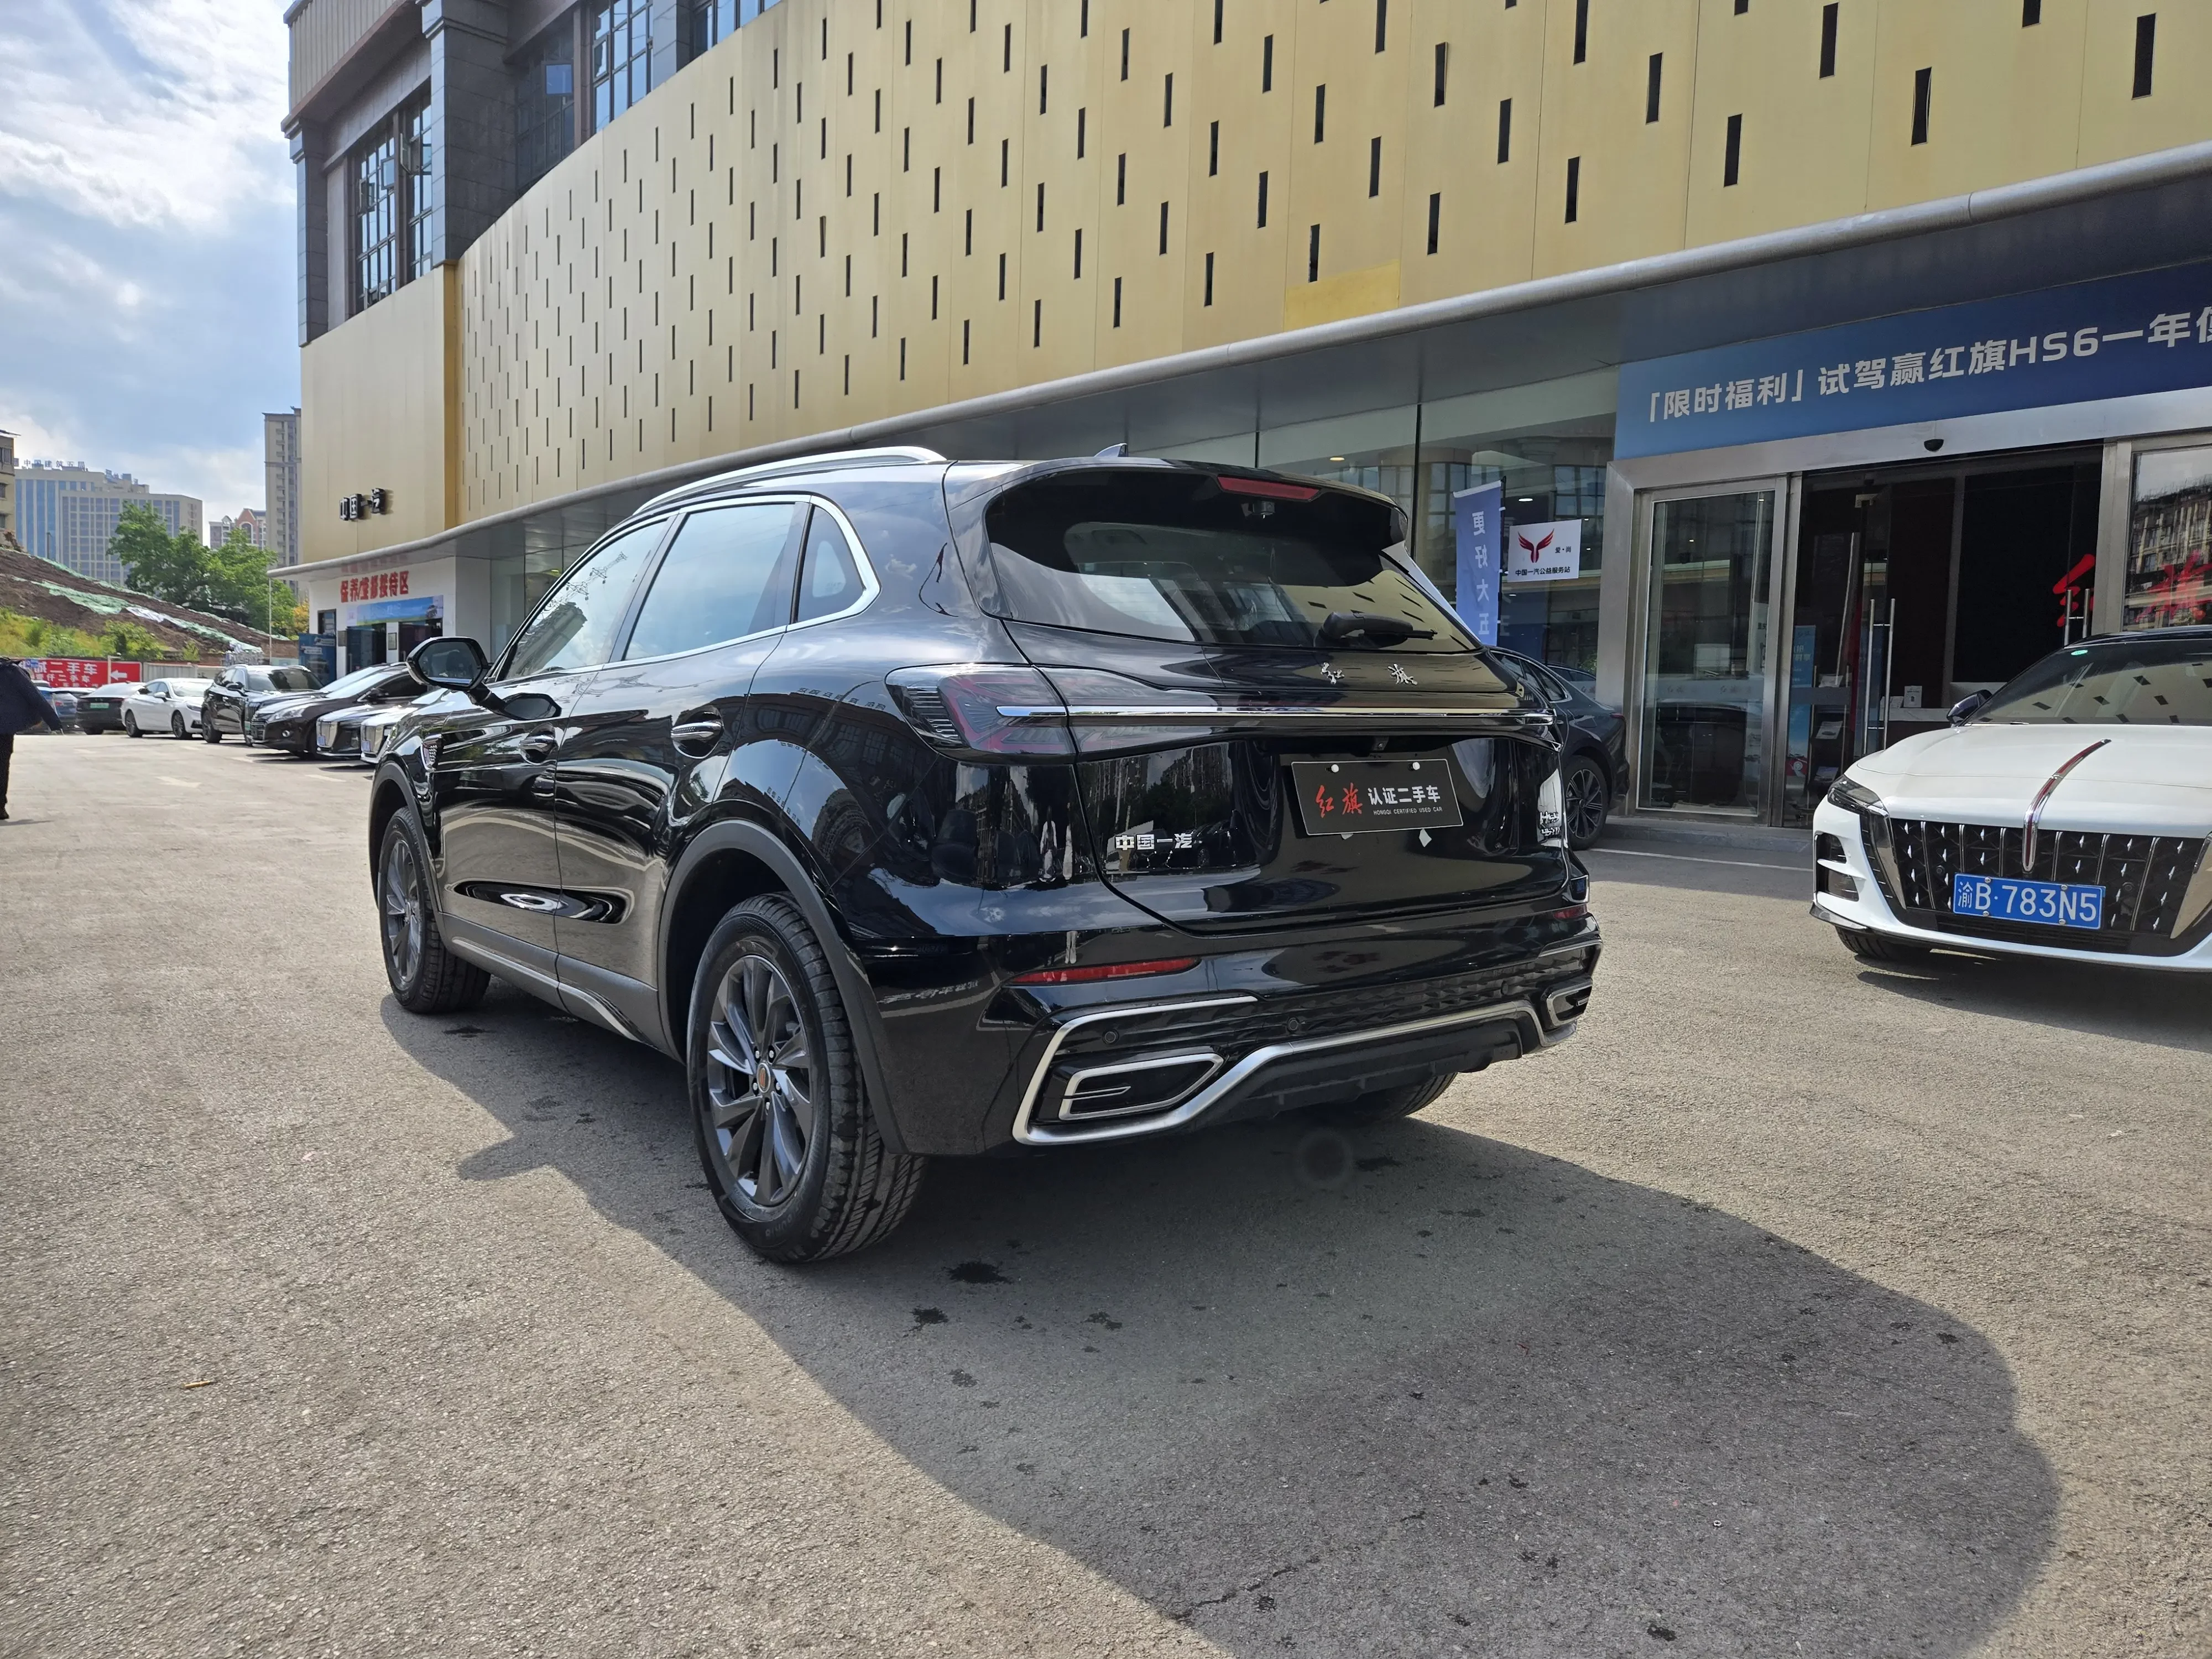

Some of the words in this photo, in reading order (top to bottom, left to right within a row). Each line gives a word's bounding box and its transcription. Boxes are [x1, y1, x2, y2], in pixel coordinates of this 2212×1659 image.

[339, 488, 385, 521] 中国一汽
[1515, 566, 1571, 576] 中国一汽公益服务站
[1316, 782, 1363, 818] 红旗
[1368, 785, 1441, 805] 认证二手车
[1115, 833, 1192, 851] 中国一汽
[1958, 881, 2098, 922] 渝B·783N5
